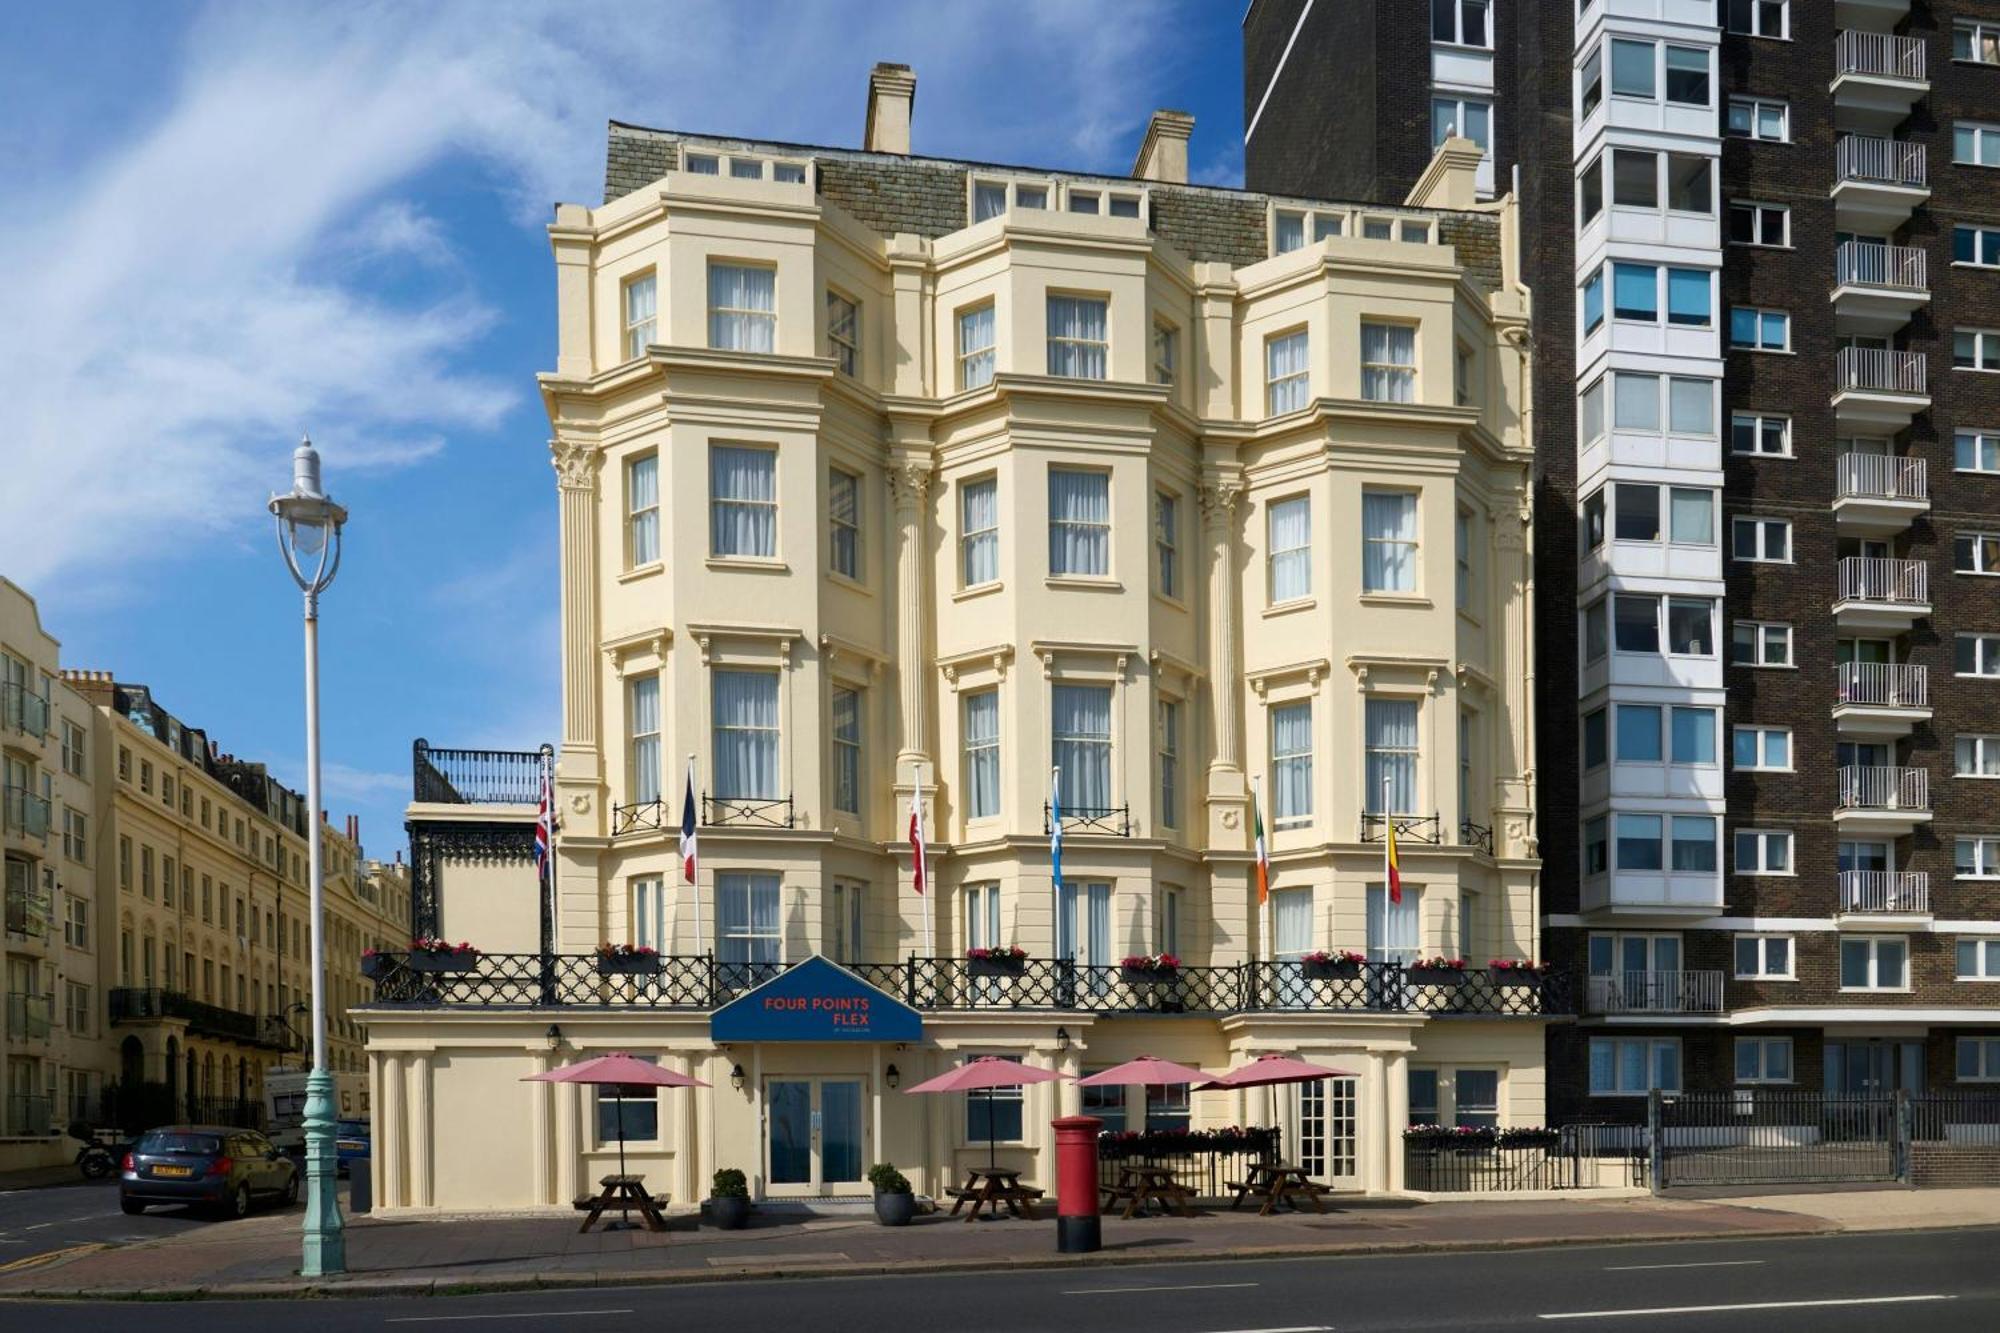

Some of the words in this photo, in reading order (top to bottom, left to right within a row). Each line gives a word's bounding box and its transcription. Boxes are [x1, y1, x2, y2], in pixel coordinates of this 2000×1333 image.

[765, 998, 807, 1010] FOUR
[812, 998, 869, 1010] POINTS
[833, 1013, 869, 1025] FLEX
